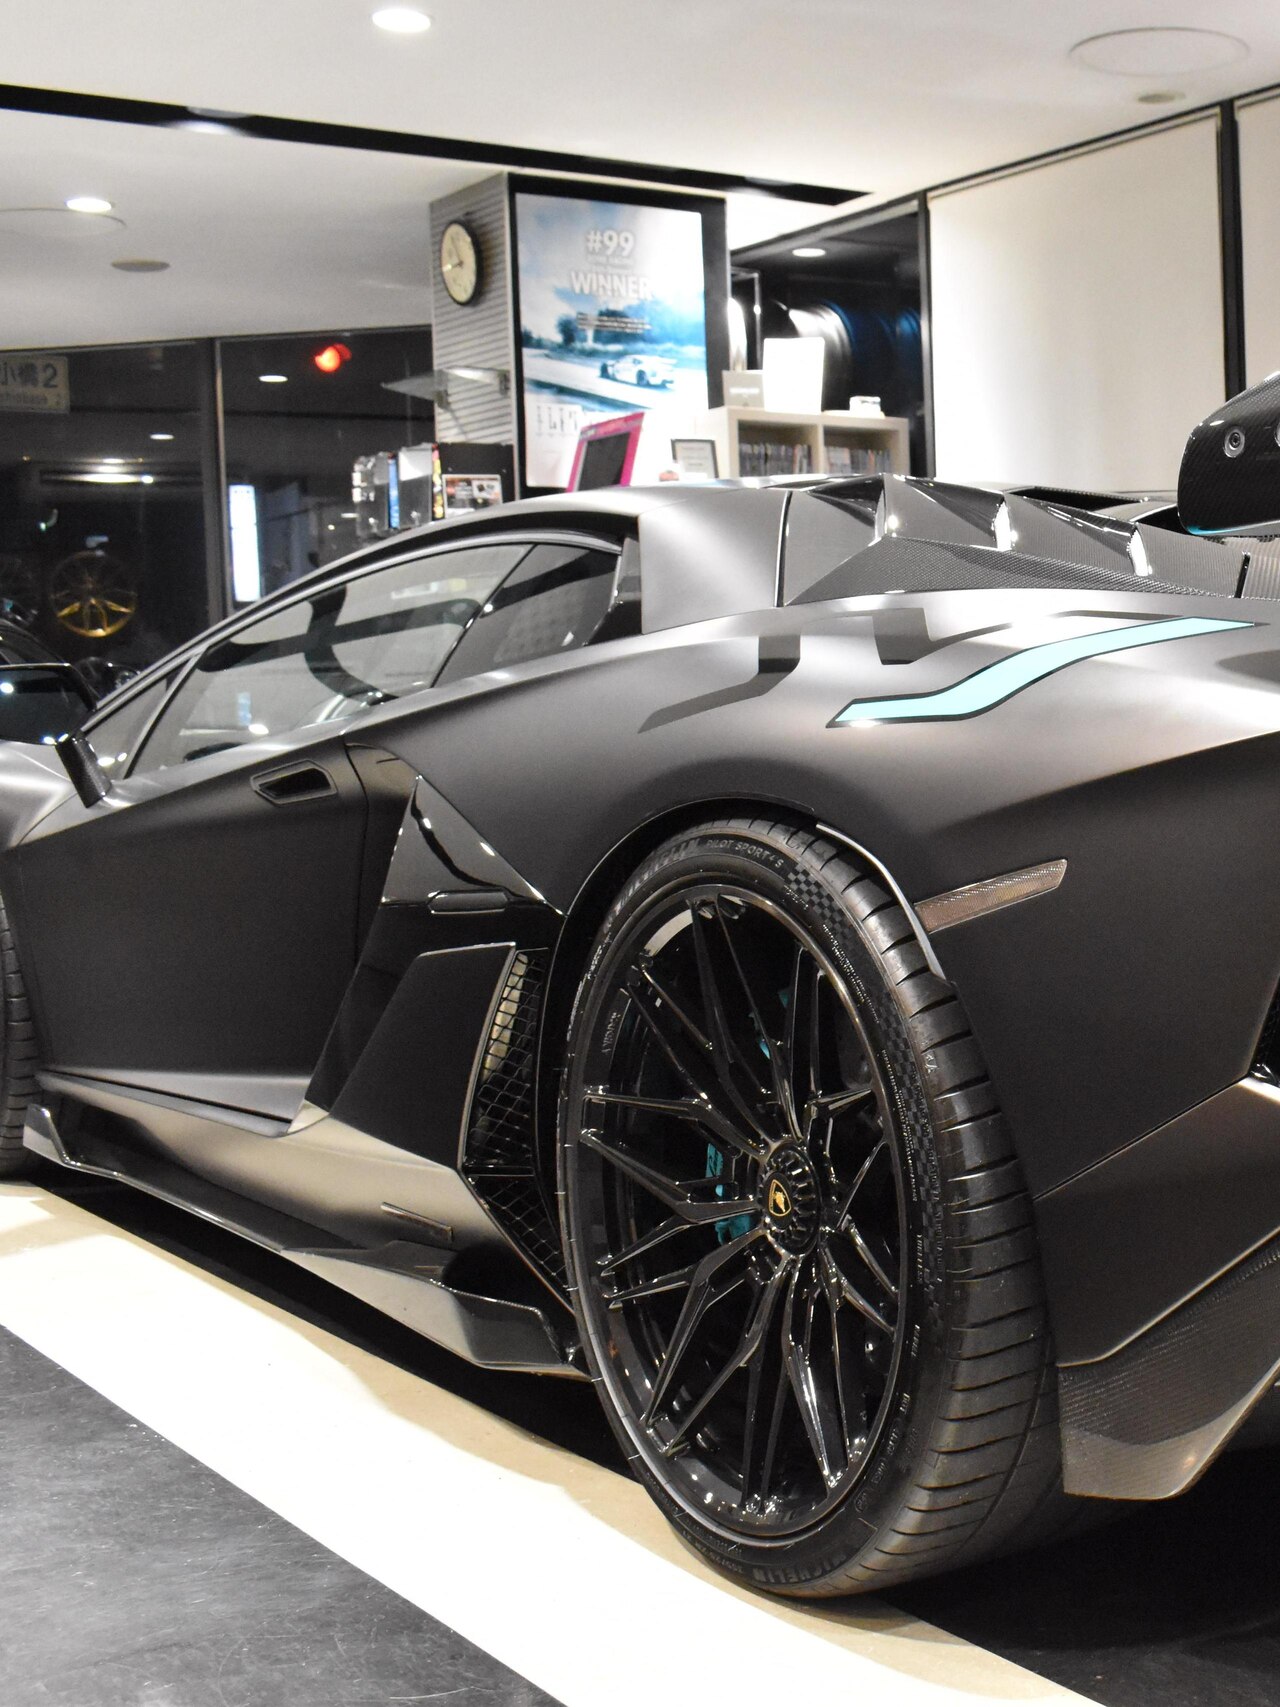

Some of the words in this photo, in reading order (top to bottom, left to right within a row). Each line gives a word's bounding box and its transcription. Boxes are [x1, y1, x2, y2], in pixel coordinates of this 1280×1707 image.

[586, 230, 634, 257] #99
[571, 271, 655, 301] WINNER
[706, 839, 735, 850] PILOT
[735, 841, 771, 860] SPORT
